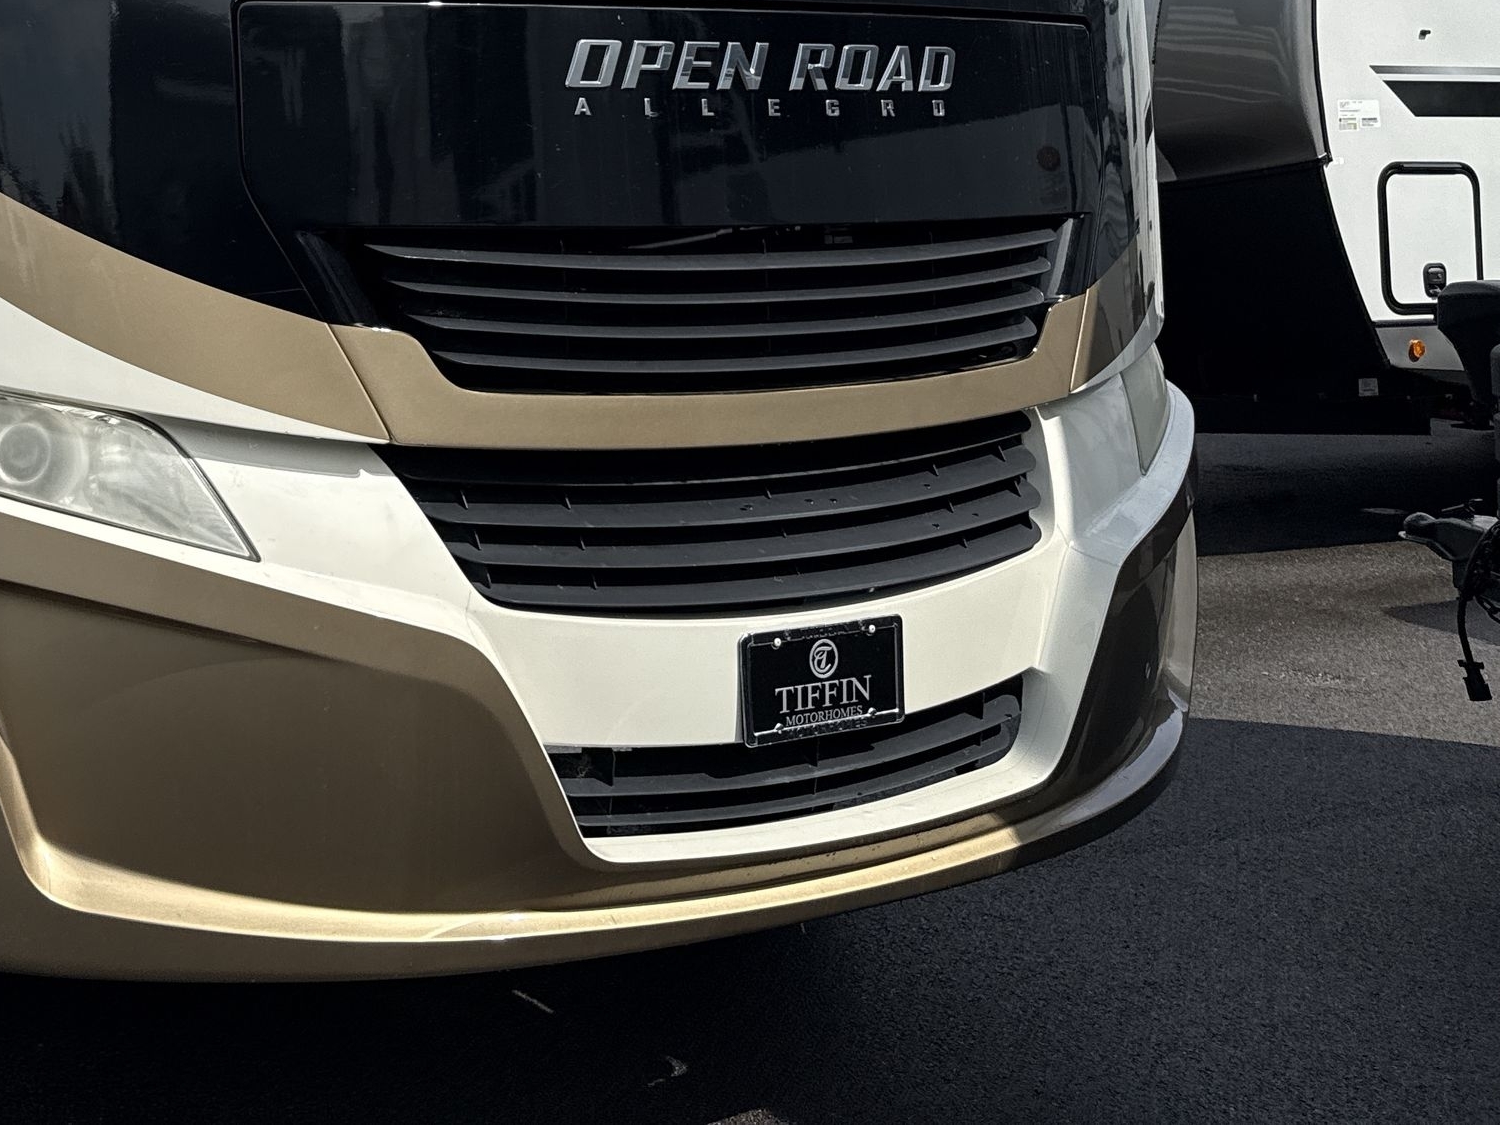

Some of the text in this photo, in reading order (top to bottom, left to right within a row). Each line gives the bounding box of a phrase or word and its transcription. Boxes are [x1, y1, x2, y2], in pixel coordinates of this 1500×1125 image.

[565, 39, 956, 92] OPEN ROAD
[574, 97, 946, 117] ALLEGRO
[774, 675, 872, 714] TIFFIN
[785, 705, 863, 727] MOTORHOMES
